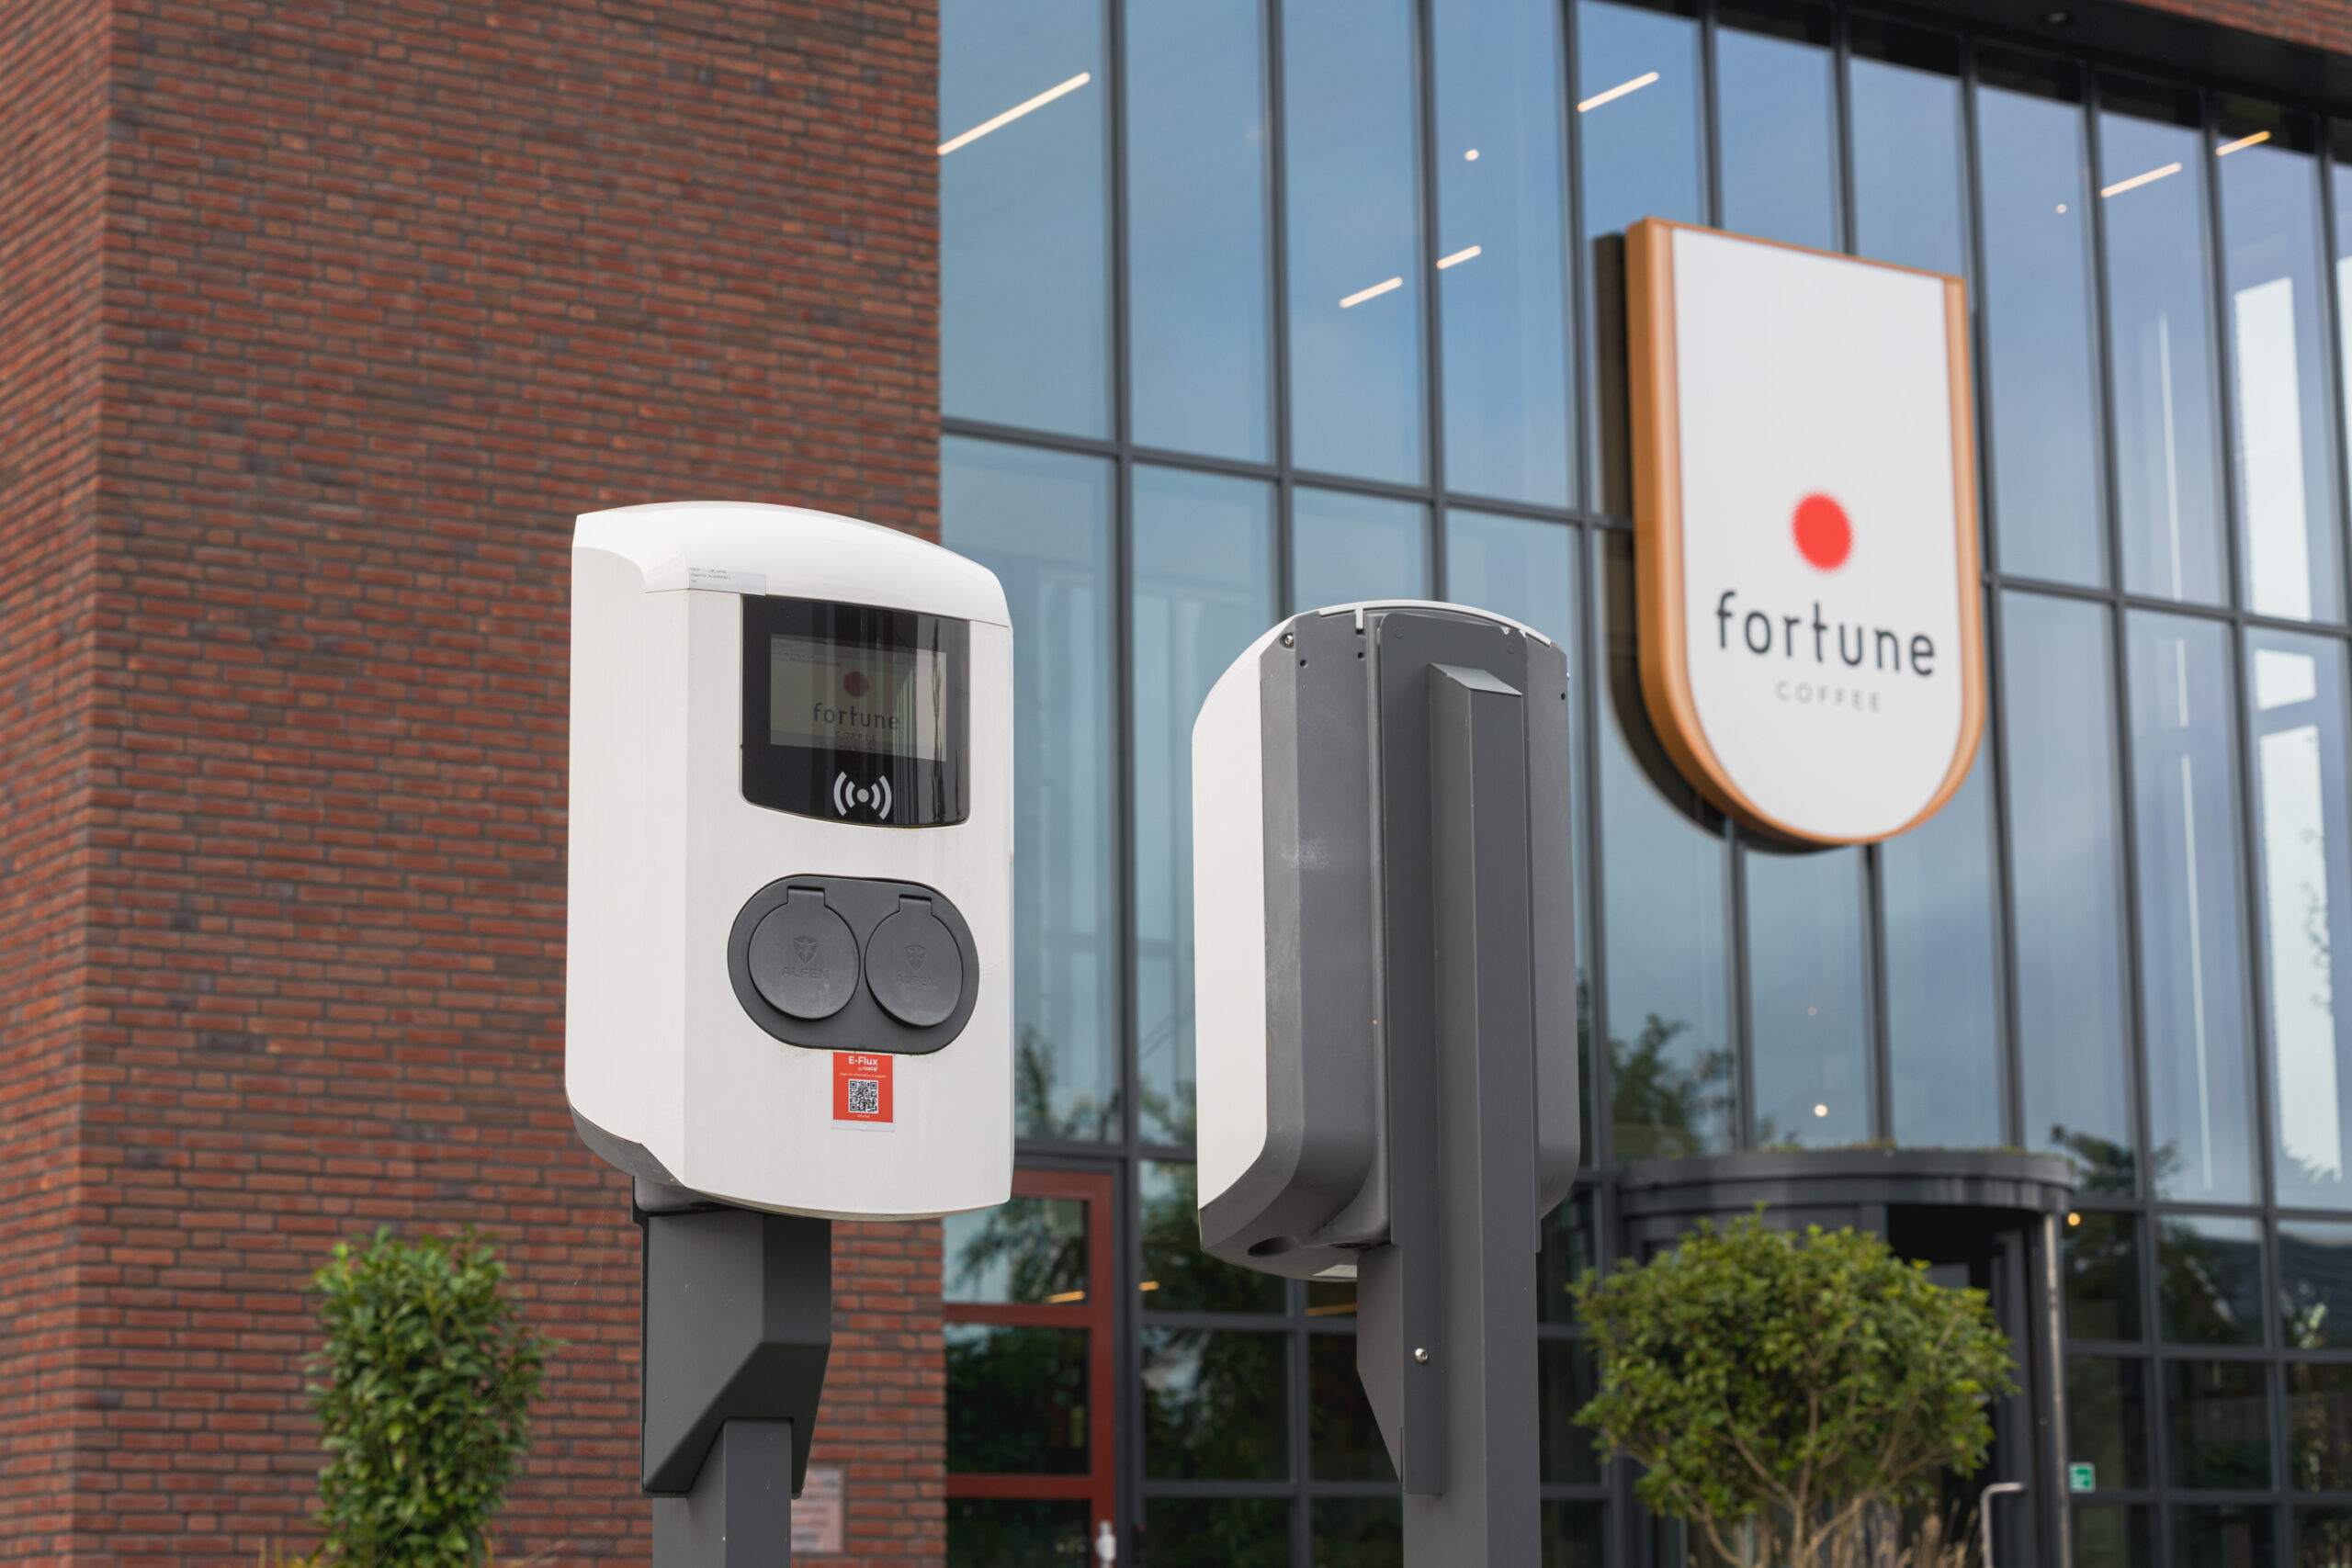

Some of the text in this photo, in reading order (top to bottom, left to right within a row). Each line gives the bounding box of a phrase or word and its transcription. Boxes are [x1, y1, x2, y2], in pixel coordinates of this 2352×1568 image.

[1716, 591, 1935, 676] fortune
[1775, 680, 1882, 713] COFFEE
[813, 702, 899, 730] fortune
[781, 966, 830, 979] ALFEN
[848, 1055, 878, 1066] E-Flux
